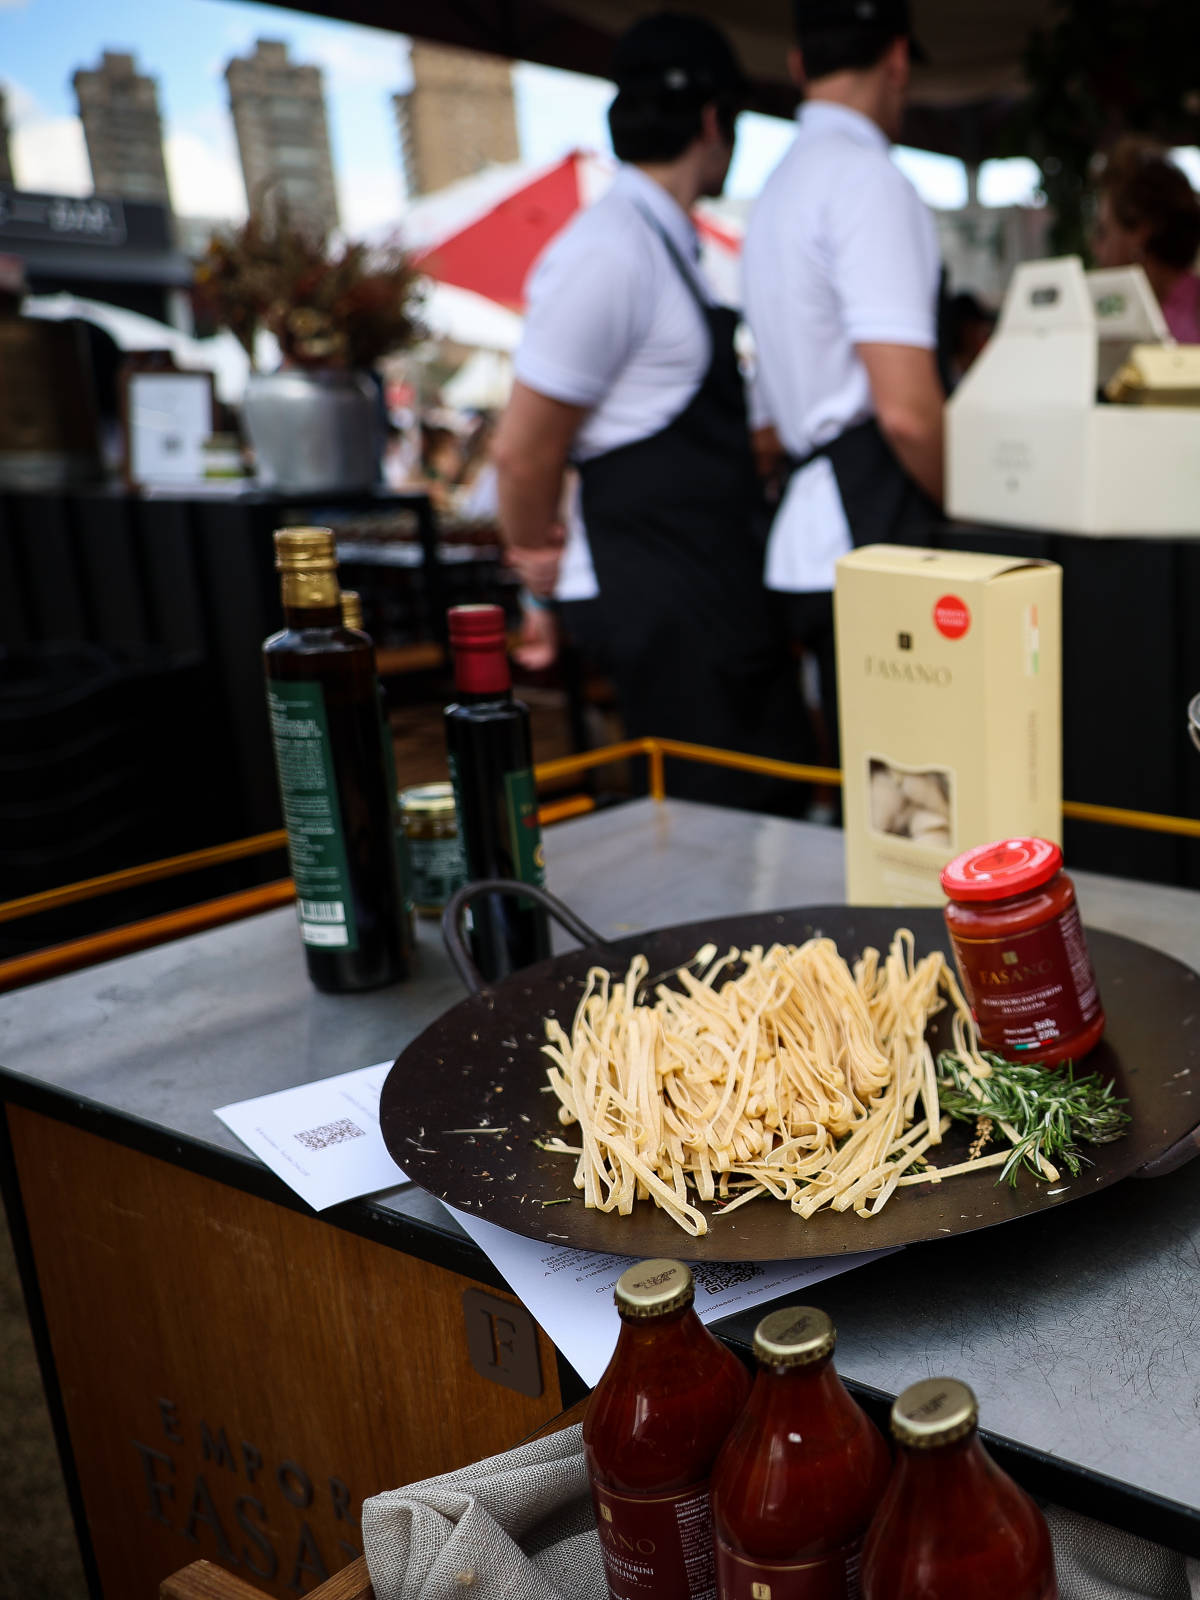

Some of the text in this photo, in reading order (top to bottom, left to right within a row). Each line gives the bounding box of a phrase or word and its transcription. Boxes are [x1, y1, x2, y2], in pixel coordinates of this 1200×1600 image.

[553, 1262, 576, 1272] linha
[480, 1309, 516, 1373] F
[158, 1397, 360, 1527] EMPOR
[130, 1438, 361, 1594] FASA
[605, 1527, 656, 1555] ANO
